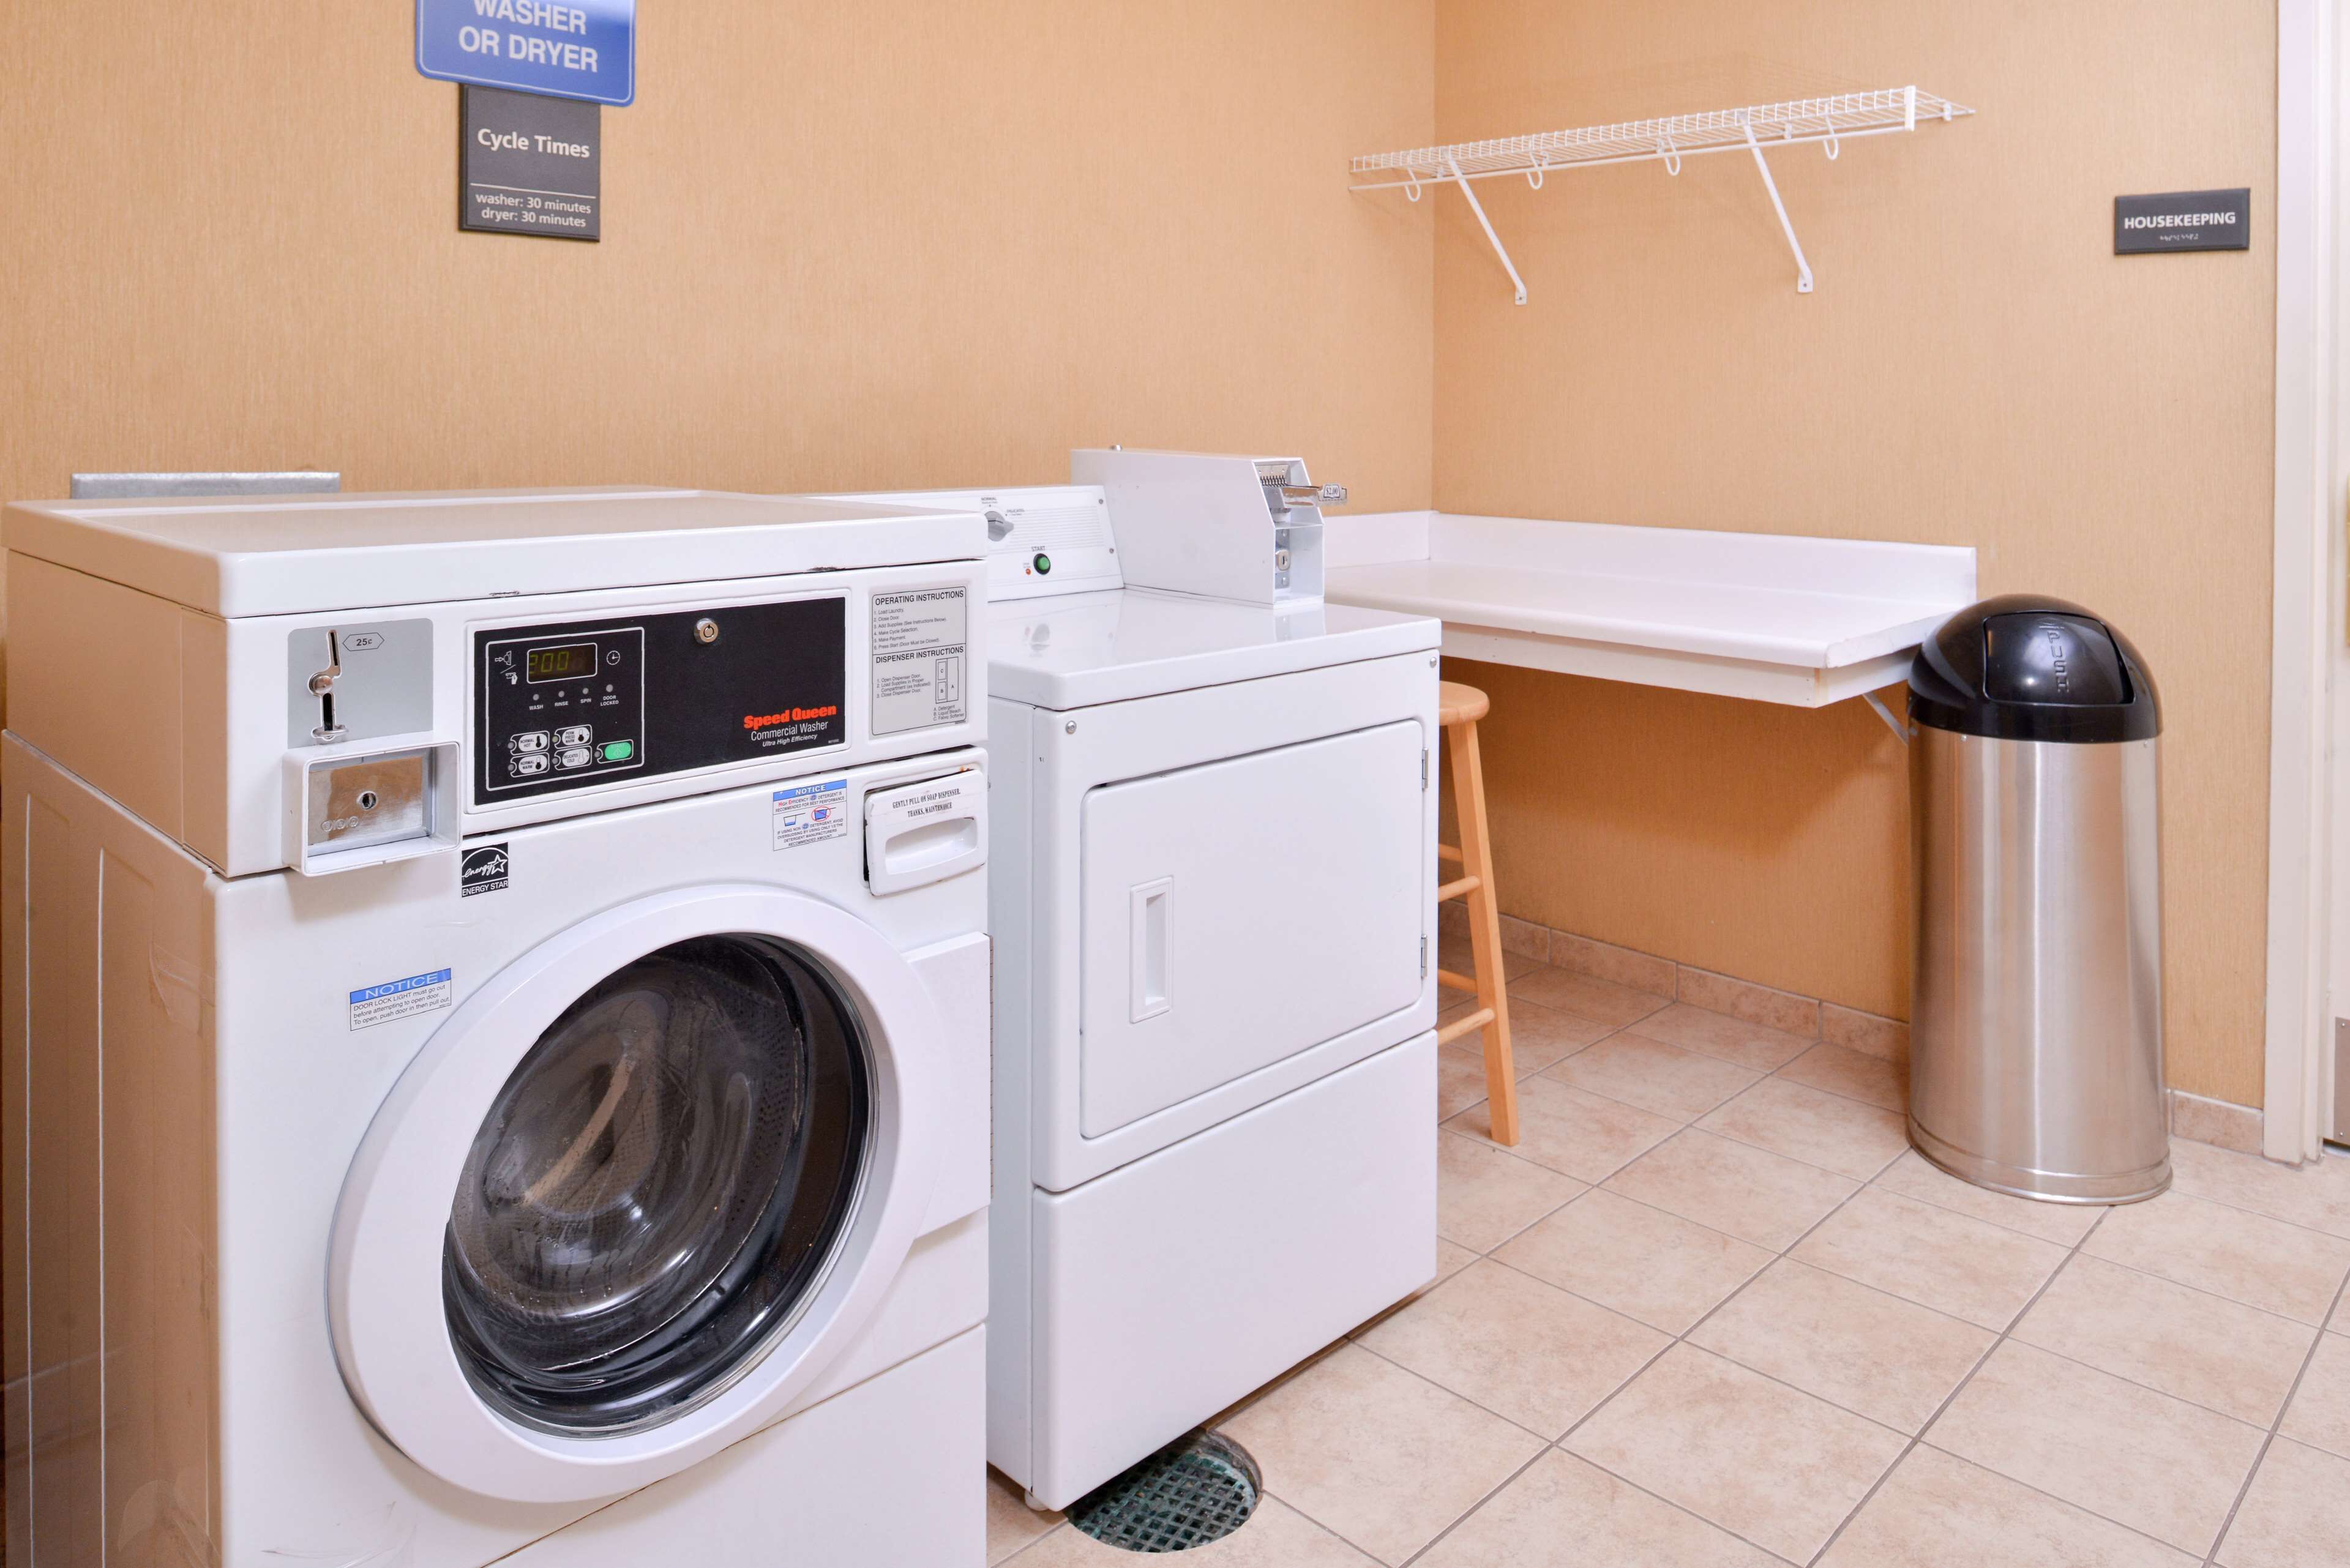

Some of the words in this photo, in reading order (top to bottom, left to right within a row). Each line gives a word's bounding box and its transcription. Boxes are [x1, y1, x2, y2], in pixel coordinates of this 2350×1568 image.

[473, 0, 586, 35] WASHER
[458, 26, 500, 56] OR
[509, 34, 597, 73] DRYER
[477, 128, 529, 151] Cycle
[534, 135, 590, 158] Times
[475, 193, 523, 207] washer:
[526, 196, 541, 209] 30
[544, 200, 591, 214] minutes
[481, 207, 518, 222] dryer:
[521, 211, 536, 223] 30
[539, 214, 586, 227] minutes
[2124, 212, 2236, 230] HOUSEKEEPING
[875, 595, 914, 605] OPERATING
[916, 590, 964, 602] INSTRUCTIONS
[876, 652, 915, 663] DISPENSER
[916, 646, 964, 658] INSTRUCTIONS
[2047, 630, 2069, 693] PUSH
[744, 710, 790, 730] Speed
[791, 705, 837, 721] Queen
[750, 724, 798, 741] Commercial
[799, 721, 828, 733] Washer
[791, 734, 817, 743] Efficiency
[795, 785, 826, 795] NOTICE
[892, 799, 908, 808] GENTLY
[909, 797, 920, 805] PULL
[927, 793, 937, 801] SOAP
[938, 788, 960, 799] DISPENSER.
[776, 804, 801, 813] RECOMMENDED
[907, 809, 925, 818] THANKS,
[925, 802, 952, 813] MAINTENANCE
[788, 837, 817, 846] RECOMMENDED
[463, 863, 493, 878] energy
[462, 884, 489, 897] ENERGY
[490, 880, 508, 890] STAR
[365, 973, 438, 999] NOTICE
[353, 1002, 373, 1011] DOOR
[375, 997, 392, 1006] LOCK
[394, 992, 411, 1001] LIGHT
[353, 1010, 372, 1018] before
[373, 1002, 403, 1014] attempting
[362, 1015, 378, 1024] open,
[380, 1011, 394, 1020] push
